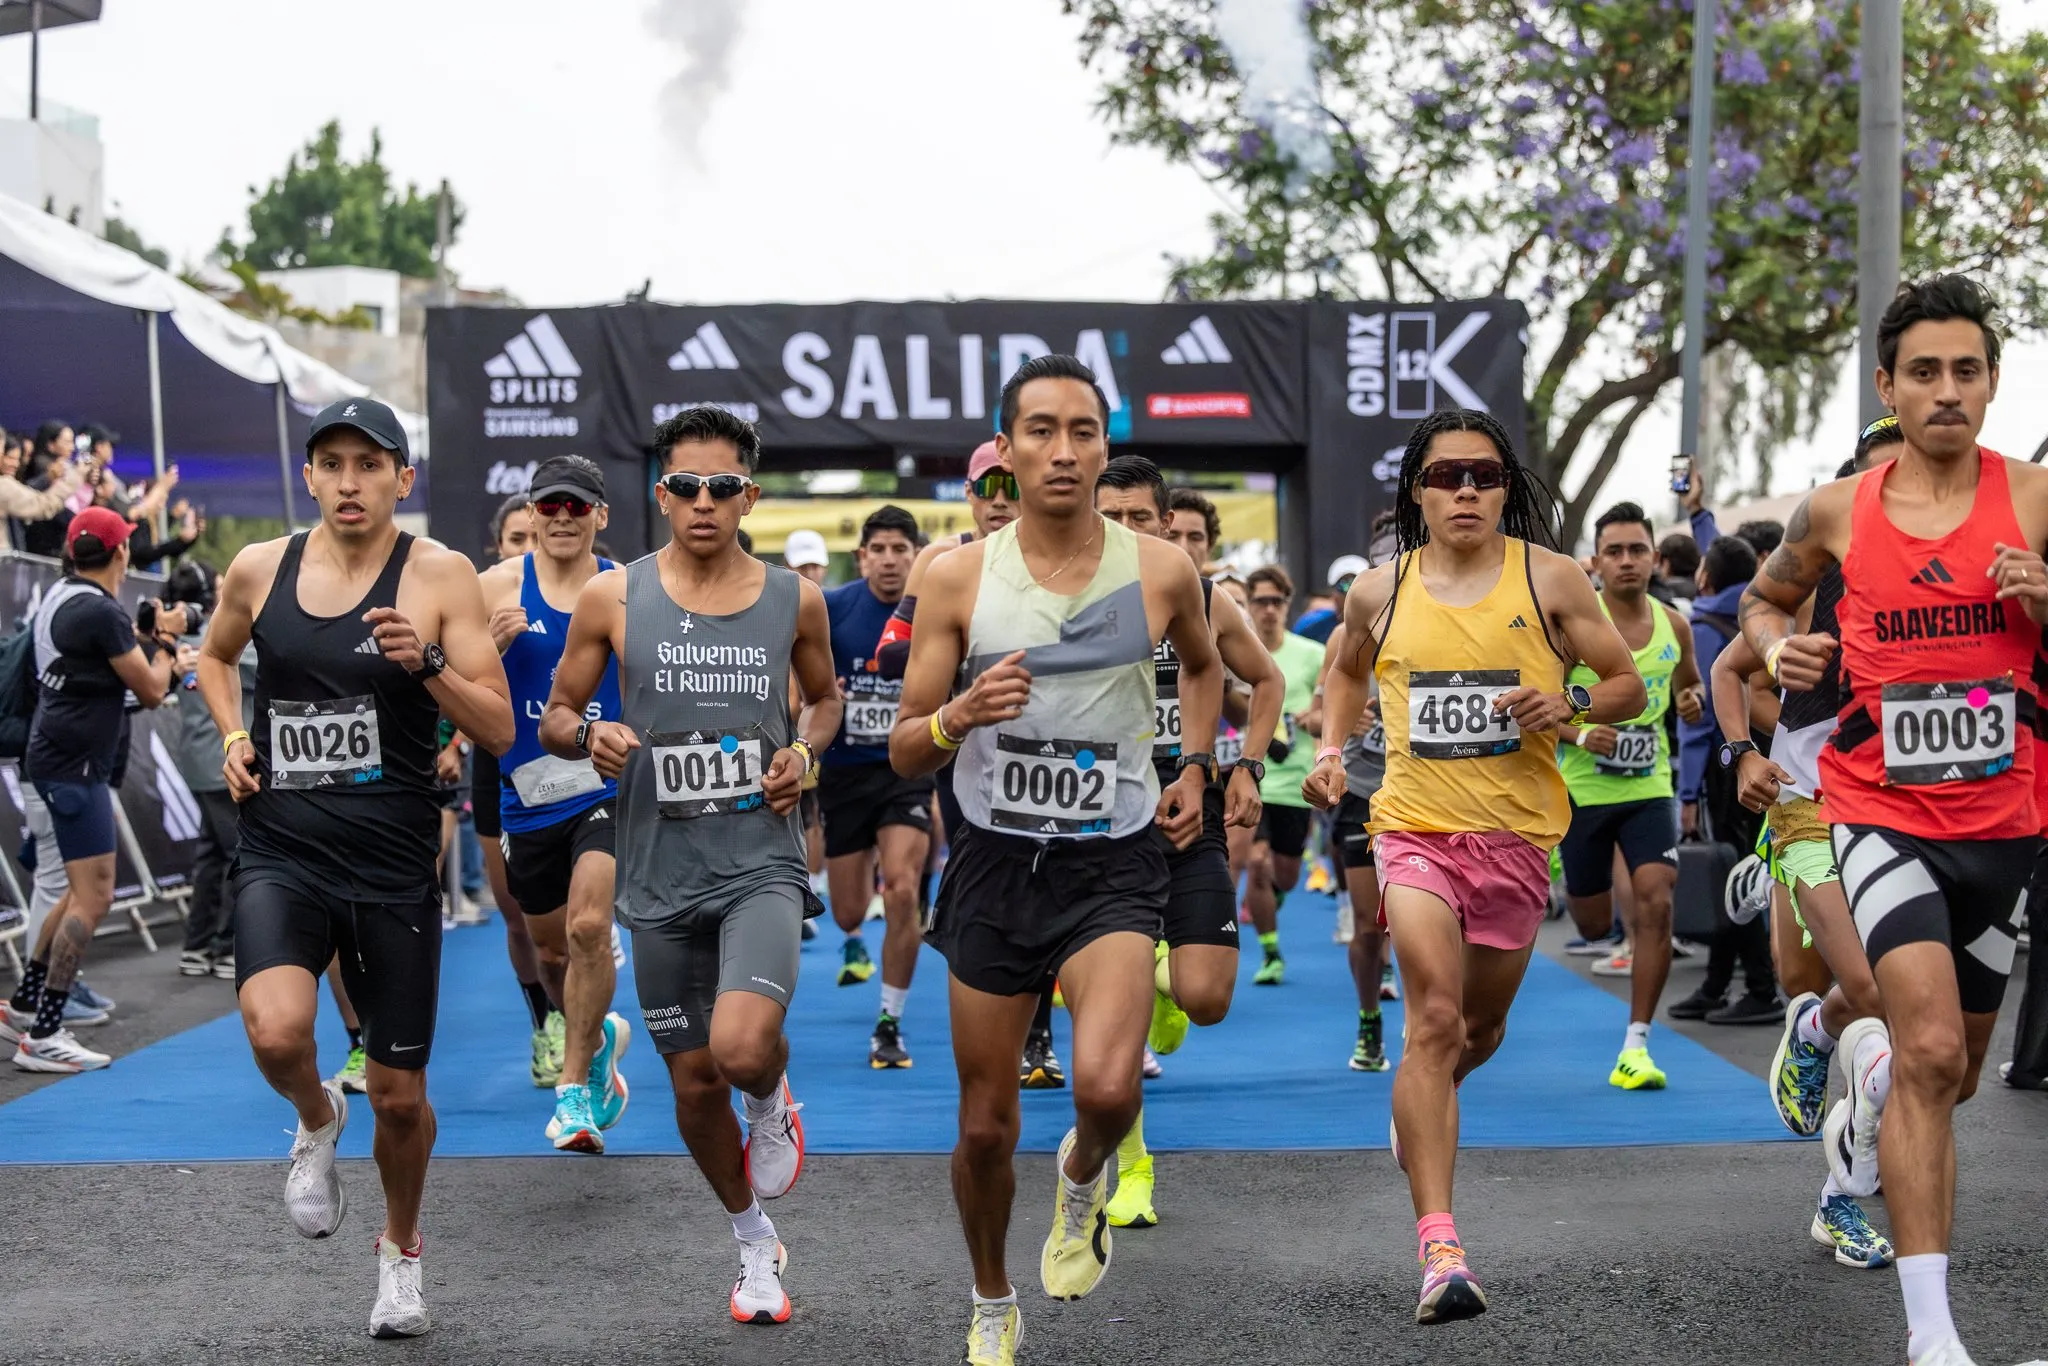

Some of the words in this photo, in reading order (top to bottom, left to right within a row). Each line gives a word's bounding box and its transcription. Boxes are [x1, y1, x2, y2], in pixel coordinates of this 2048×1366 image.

[1347, 313, 1385, 416] CDMX
[1398, 349, 1428, 381] 12
[490, 379, 578, 403] SPLITS
[484, 416, 579, 437] SAMSUNG
[1874, 602, 2006, 642] SAAVEDRA
[657, 641, 767, 666] Salvemos
[655, 669, 674, 693] El
[680, 669, 770, 702] Running
[852, 705, 899, 730] 480
[1155, 704, 1181, 738] 36
[1418, 694, 1511, 734] 4684
[1894, 704, 2005, 755] 0003
[280, 720, 370, 762] 0026
[1451, 745, 1479, 755] Avène
[663, 749, 752, 793] 0011
[1003, 761, 1105, 811] 0002
